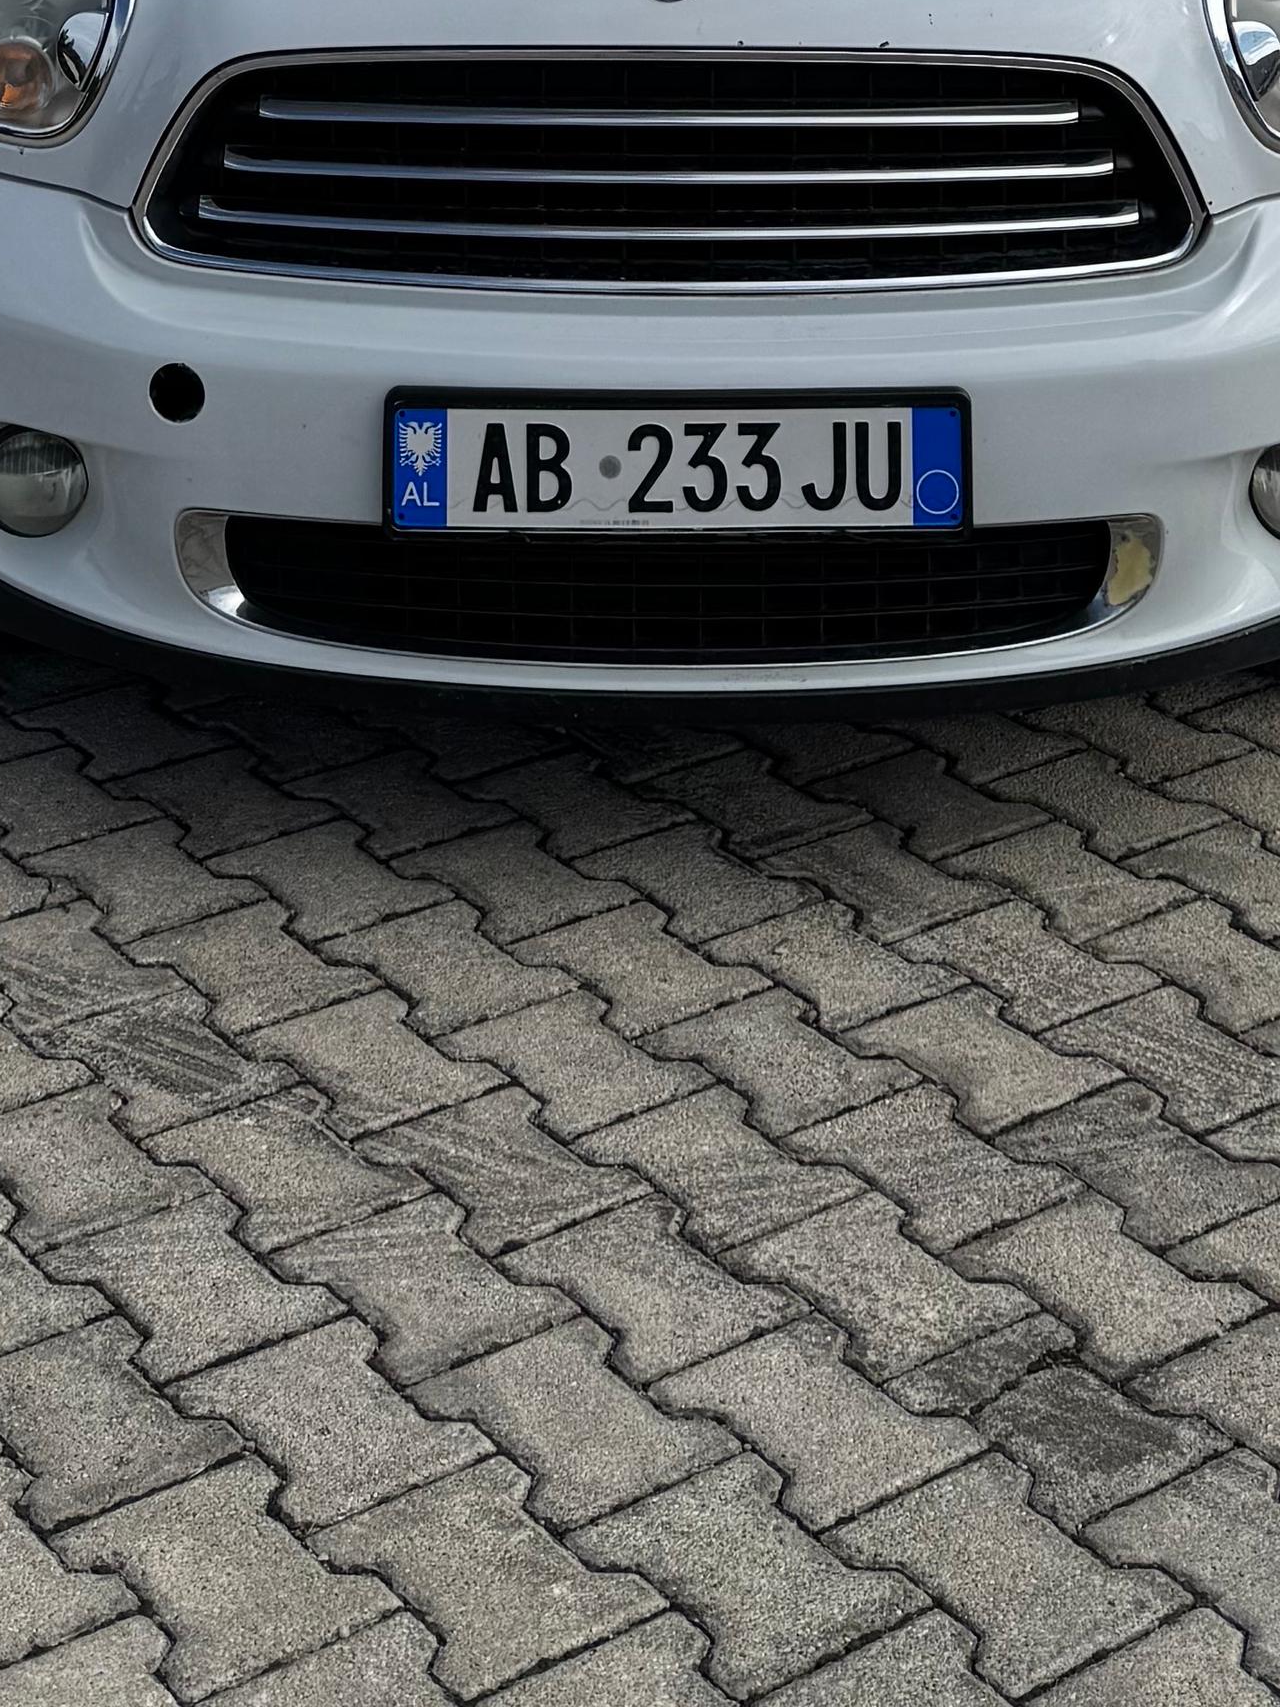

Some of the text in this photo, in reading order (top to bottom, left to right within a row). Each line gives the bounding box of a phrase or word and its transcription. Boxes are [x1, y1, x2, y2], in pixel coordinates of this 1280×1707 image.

[401, 481, 440, 507] AL
[473, 421, 902, 513] AB 233 JU
